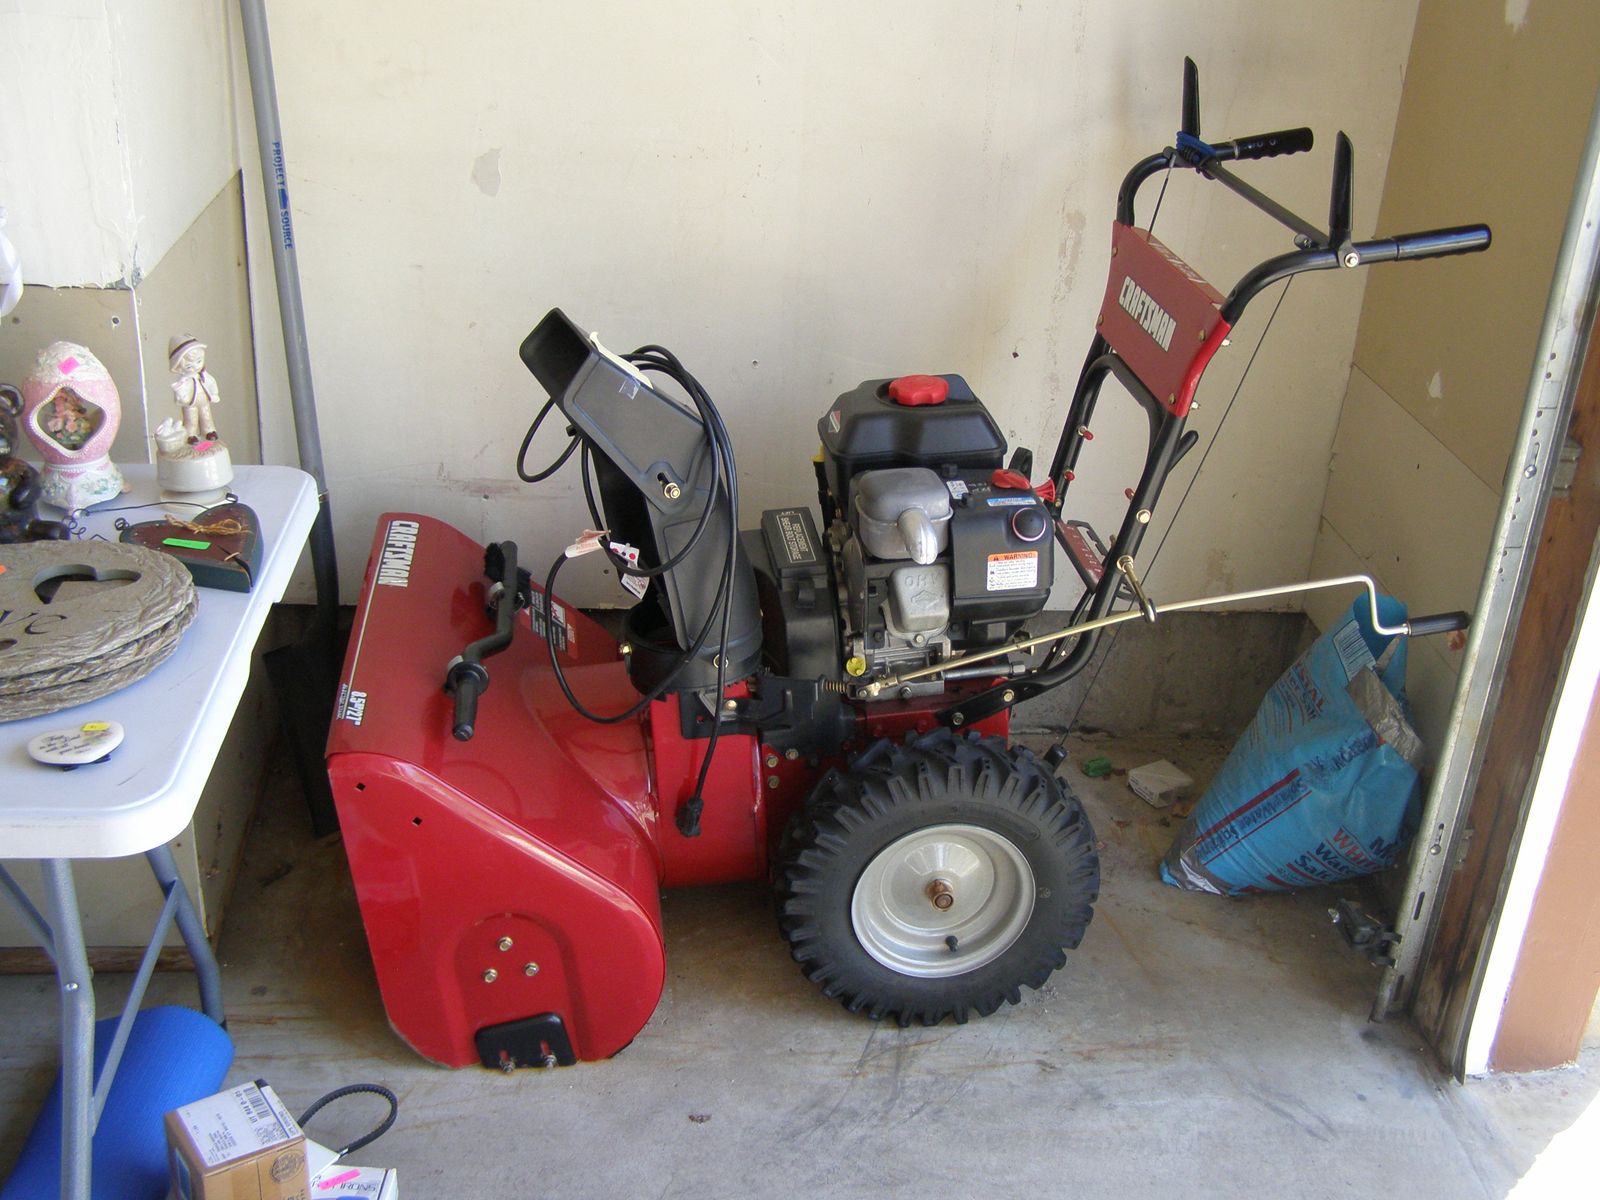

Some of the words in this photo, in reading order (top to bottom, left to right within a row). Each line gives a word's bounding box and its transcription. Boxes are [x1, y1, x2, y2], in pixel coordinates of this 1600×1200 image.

[272, 142, 285, 186] PROJECT
[280, 210, 293, 249] SOURCE
[1118, 275, 1177, 352] CRAFTSMAN
[377, 520, 420, 588] CRAFTSMAN
